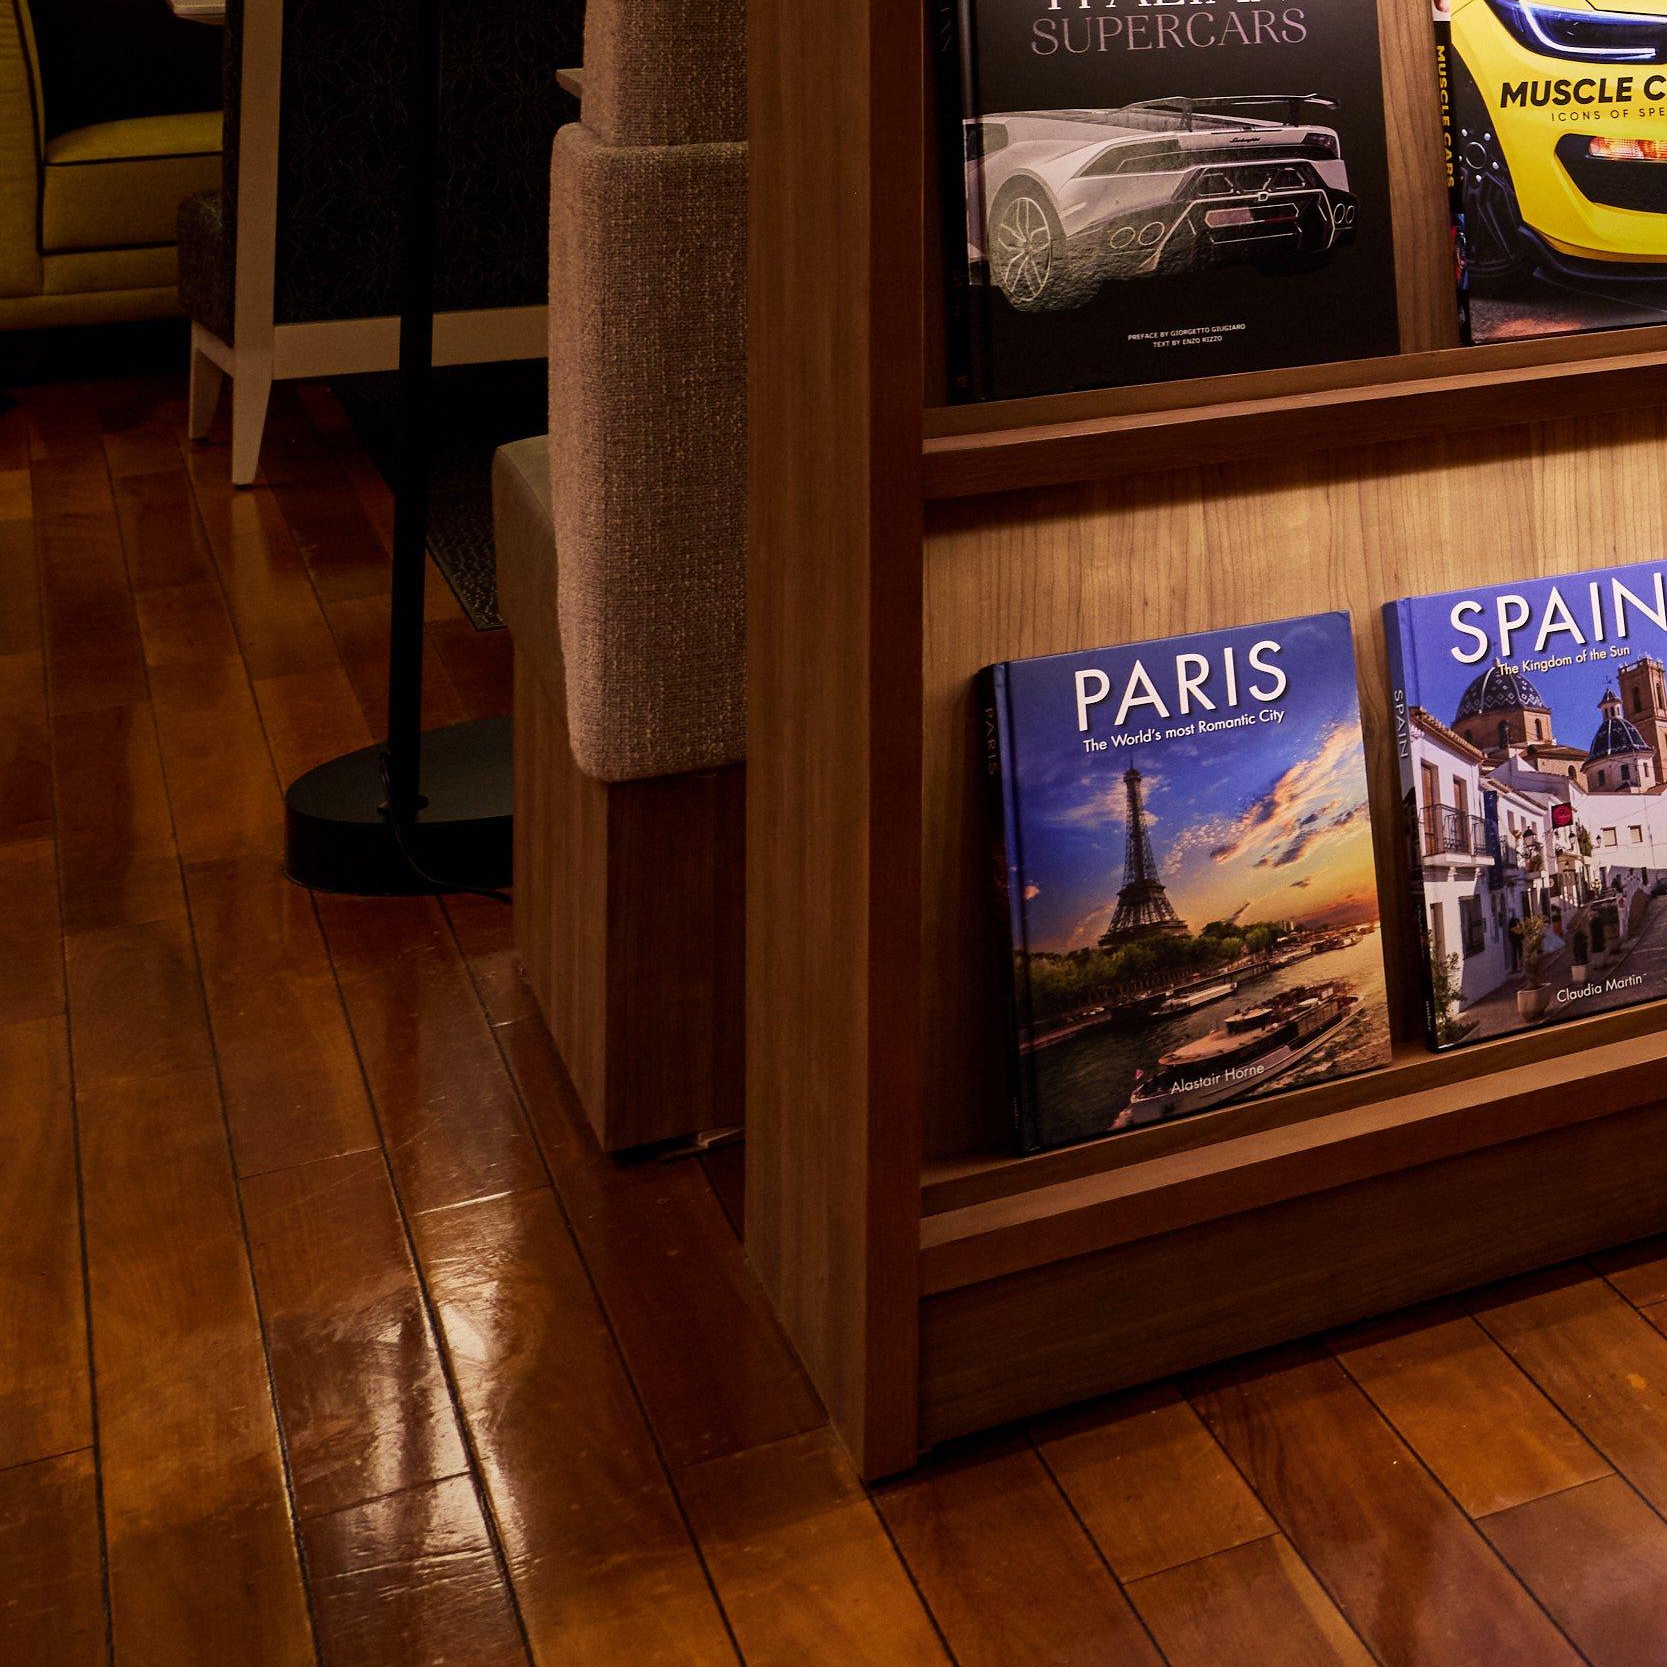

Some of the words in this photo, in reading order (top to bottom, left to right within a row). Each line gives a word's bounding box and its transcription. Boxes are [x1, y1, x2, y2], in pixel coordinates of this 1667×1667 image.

[1030, 8, 1308, 57] SUPERCARS
[1435, 45, 1451, 127] MUSCLE
[1500, 76, 1634, 109] MUSCLE
[1551, 109, 1601, 122] ICONS
[1610, 107, 1629, 120] OF
[1442, 133, 1455, 188] CARS
[1127, 332, 1158, 341] PREFACE
[1171, 326, 1210, 336] GIORGETTO
[1211, 323, 1246, 332] GIUGIARO
[1182, 337, 1200, 345] ENZO
[1202, 335, 1222, 343] RIZZO
[1499, 661, 1520, 677] The
[1521, 654, 1574, 675] Kingdom
[1576, 649, 1588, 664] of
[1590, 647, 1608, 662] the
[1610, 644, 1631, 658] Sun
[1074, 639, 1288, 732] PARIS
[1082, 736, 1107, 754] The
[1111, 728, 1162, 749] World's
[1165, 722, 1195, 741] most
[1198, 712, 1256, 736] Romantic
[1258, 706, 1286, 726] City
[1393, 689, 1409, 760] SPAIN
[1556, 982, 1603, 1004] Claudia
[1605, 973, 1644, 994] Martin
[1170, 1071, 1221, 1095] Alastair
[1224, 1062, 1265, 1085] Horne
